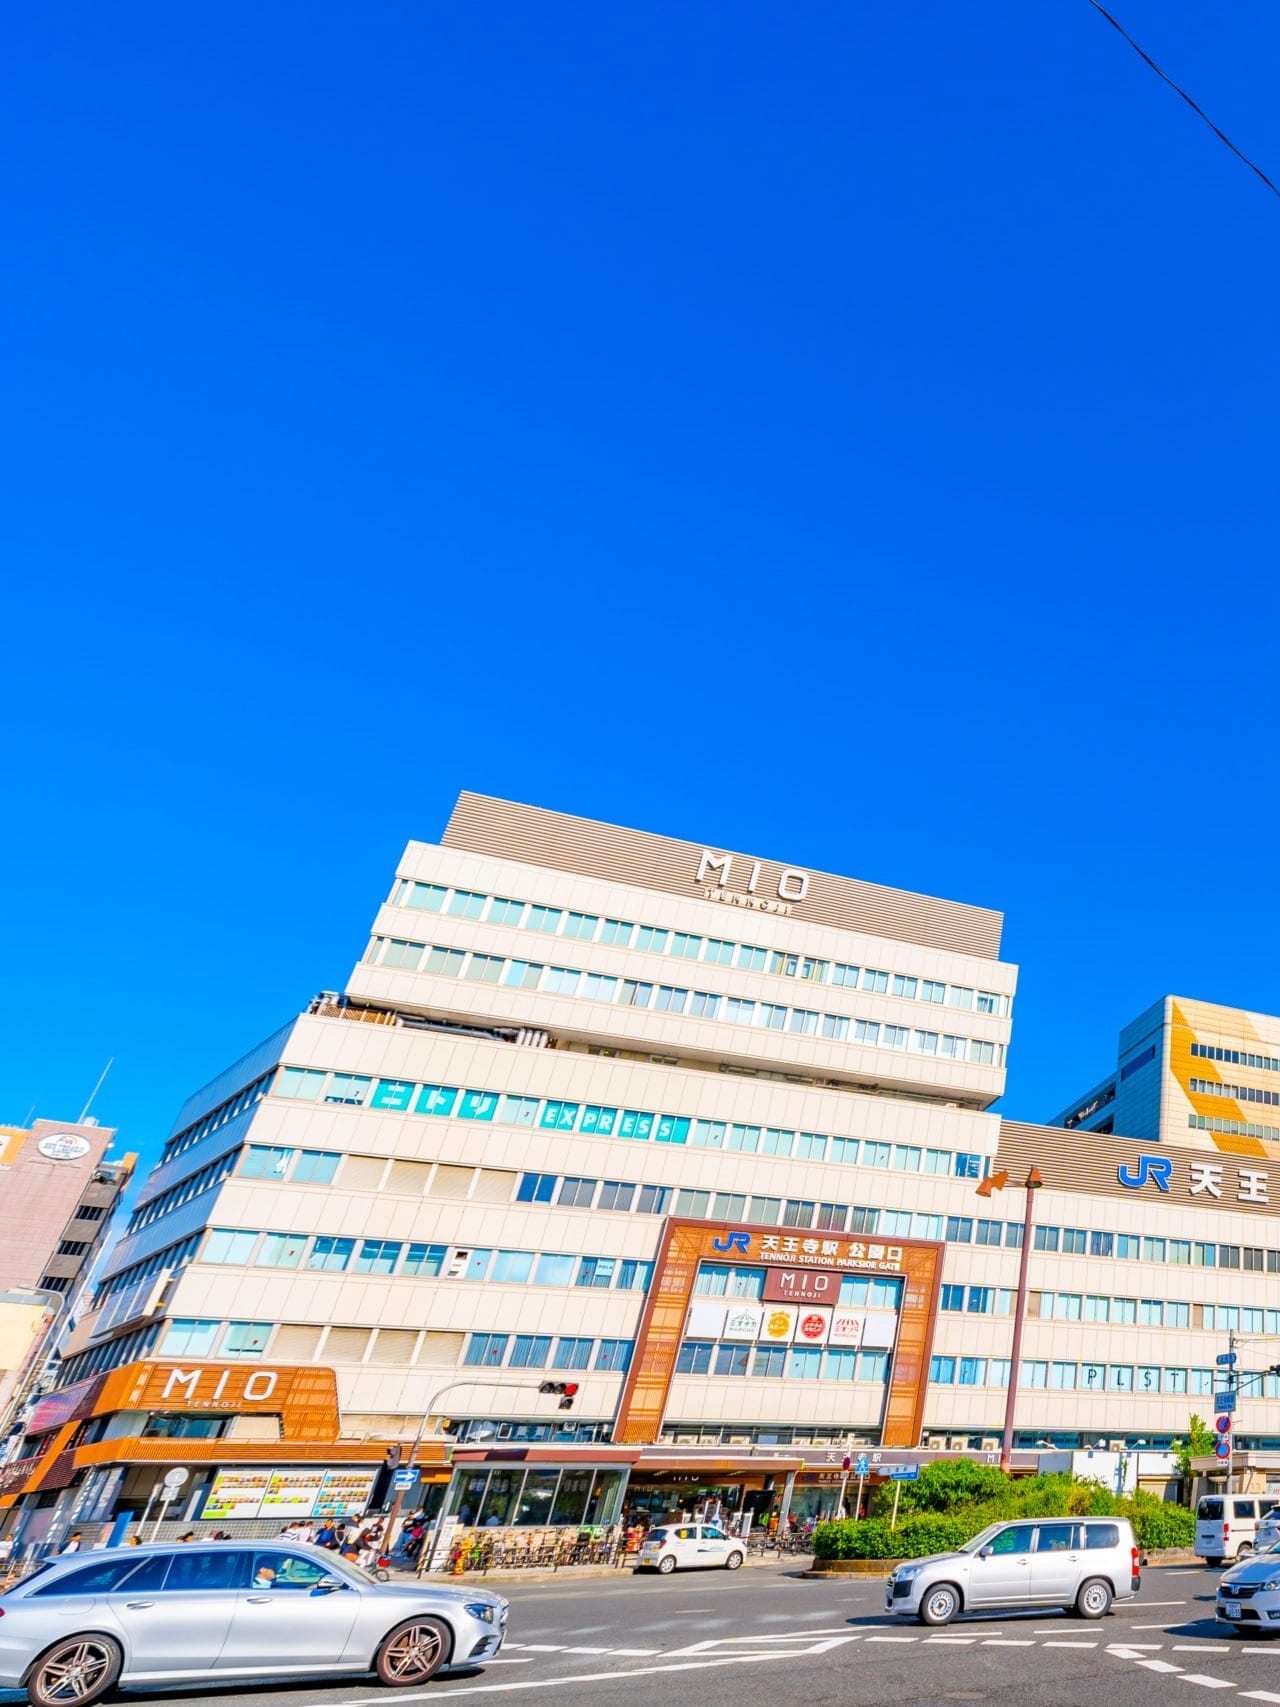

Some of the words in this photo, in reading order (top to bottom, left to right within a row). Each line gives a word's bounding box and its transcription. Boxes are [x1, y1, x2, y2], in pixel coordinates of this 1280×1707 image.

[695, 849, 810, 902] MIO
[380, 1084, 490, 1119] ニトリ
[544, 1111, 672, 1138] EXPRESS
[1117, 1153, 1174, 1192] JR
[713, 1231, 752, 1253] JR
[761, 1235, 839, 1256] 天王寺駅
[848, 1242, 903, 1262] 公園口
[798, 1254, 834, 1266] STATION
[836, 1258, 877, 1269] PARKSIDE
[879, 1261, 901, 1271] GATE
[780, 1272, 829, 1292] MIO
[783, 1290, 821, 1299] TENNOJI
[161, 1368, 279, 1401] MIO
[1087, 1368, 1180, 1389] PLST
